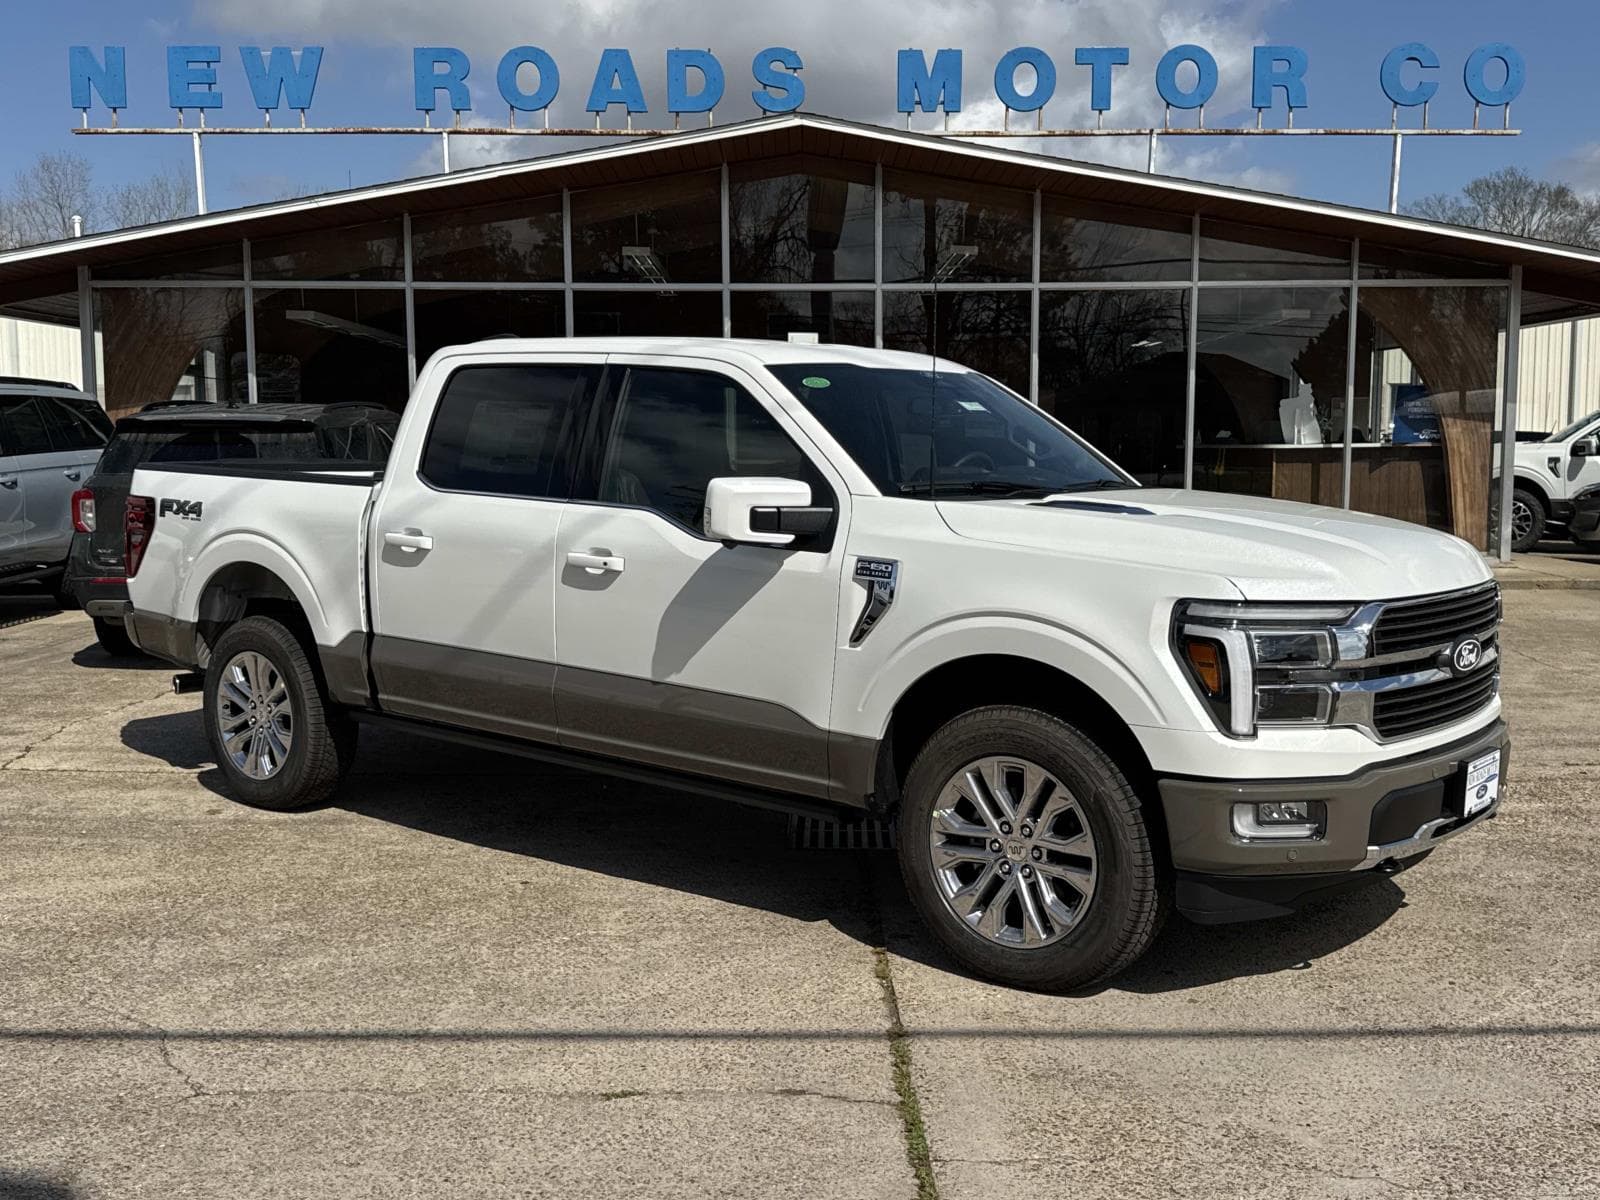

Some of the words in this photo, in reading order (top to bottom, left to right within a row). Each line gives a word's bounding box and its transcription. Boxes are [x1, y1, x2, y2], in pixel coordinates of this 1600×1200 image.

[69, 45, 324, 113] NEW
[413, 46, 805, 114] ROADS
[896, 44, 1308, 114] MOTOR
[1380, 42, 1525, 107] CO
[159, 498, 203, 517] FX4
[857, 561, 892, 571] F-150
[1459, 643, 1478, 667] Ford
